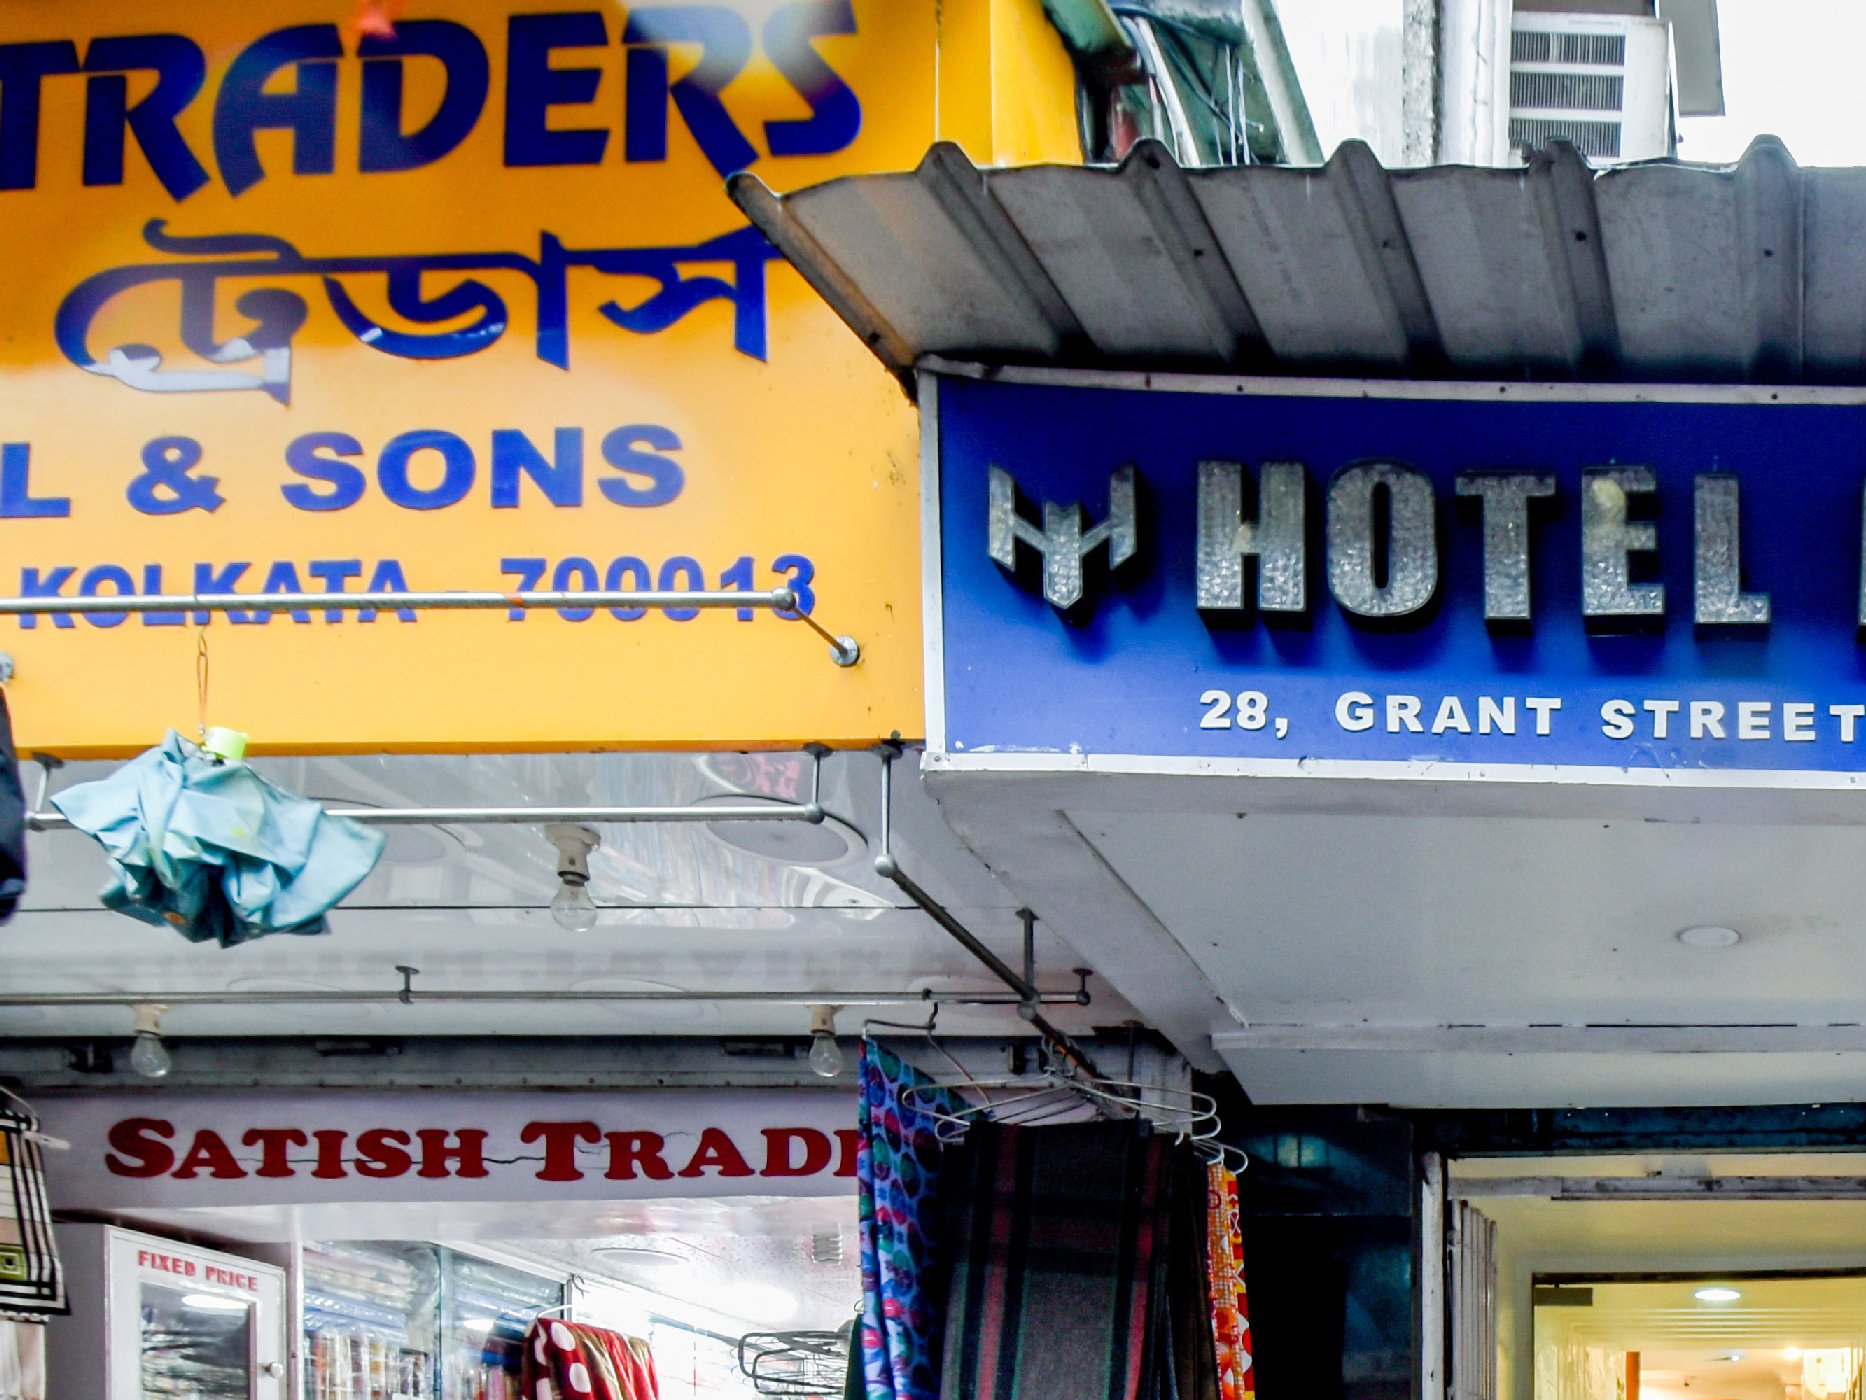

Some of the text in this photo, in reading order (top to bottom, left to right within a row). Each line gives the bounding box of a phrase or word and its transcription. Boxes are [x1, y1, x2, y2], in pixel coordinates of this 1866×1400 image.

[126, 436, 226, 516] &
[281, 424, 685, 511] SONS
[1196, 458, 1771, 628] HOTEL
[17, 555, 817, 630] KOLKATA 700013
[1200, 690, 1288, 740] 28,
[1335, 691, 1562, 737] GRANT
[104, 1116, 490, 1180] SATISH
[138, 1250, 259, 1292] FIXED PRICE
